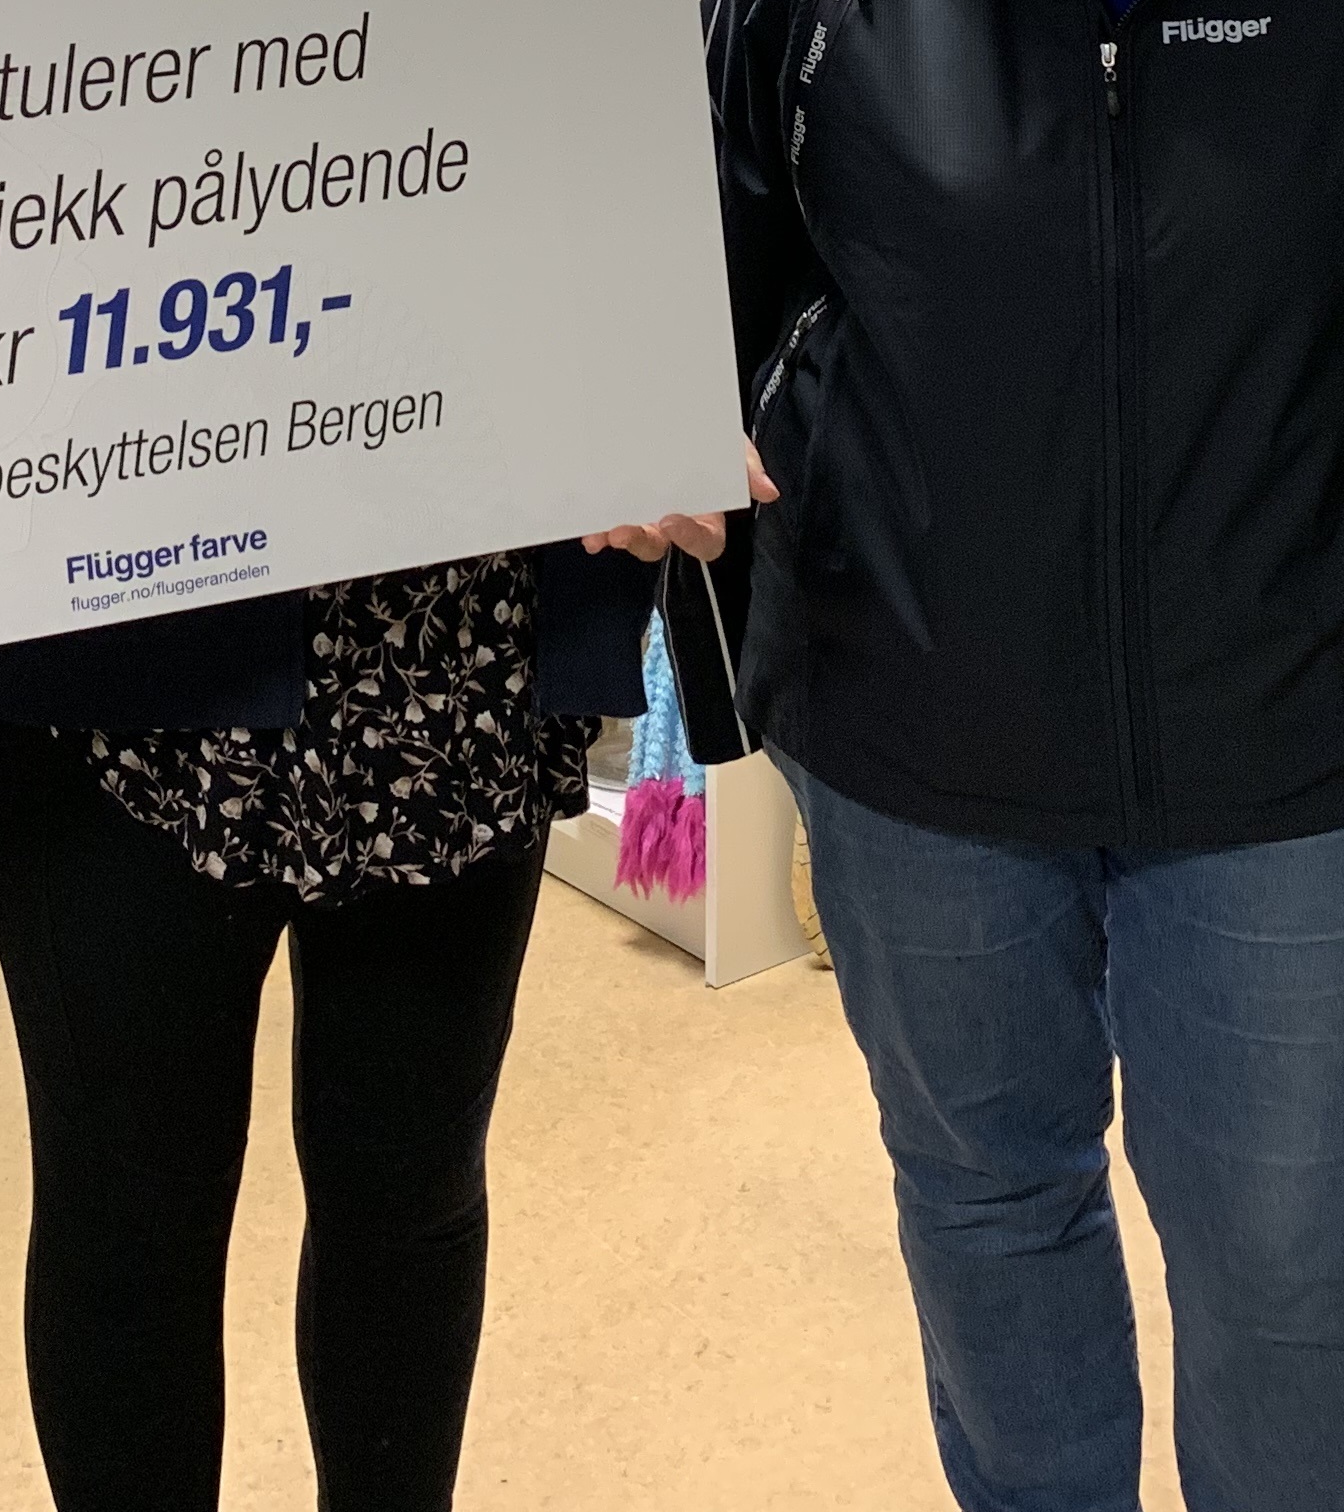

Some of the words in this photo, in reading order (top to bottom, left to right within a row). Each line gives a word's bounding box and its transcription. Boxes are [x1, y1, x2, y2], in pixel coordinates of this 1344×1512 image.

[234, 12, 370, 94] med
[799, 21, 827, 84] Flügger
[1162, 17, 1272, 44] Flügger
[149, 127, 469, 249] pålydende
[58, 265, 353, 376] 11.931,-
[288, 391, 443, 453] Bergen
[71, 564, 270, 612] flugger.no/fluggerandelen
